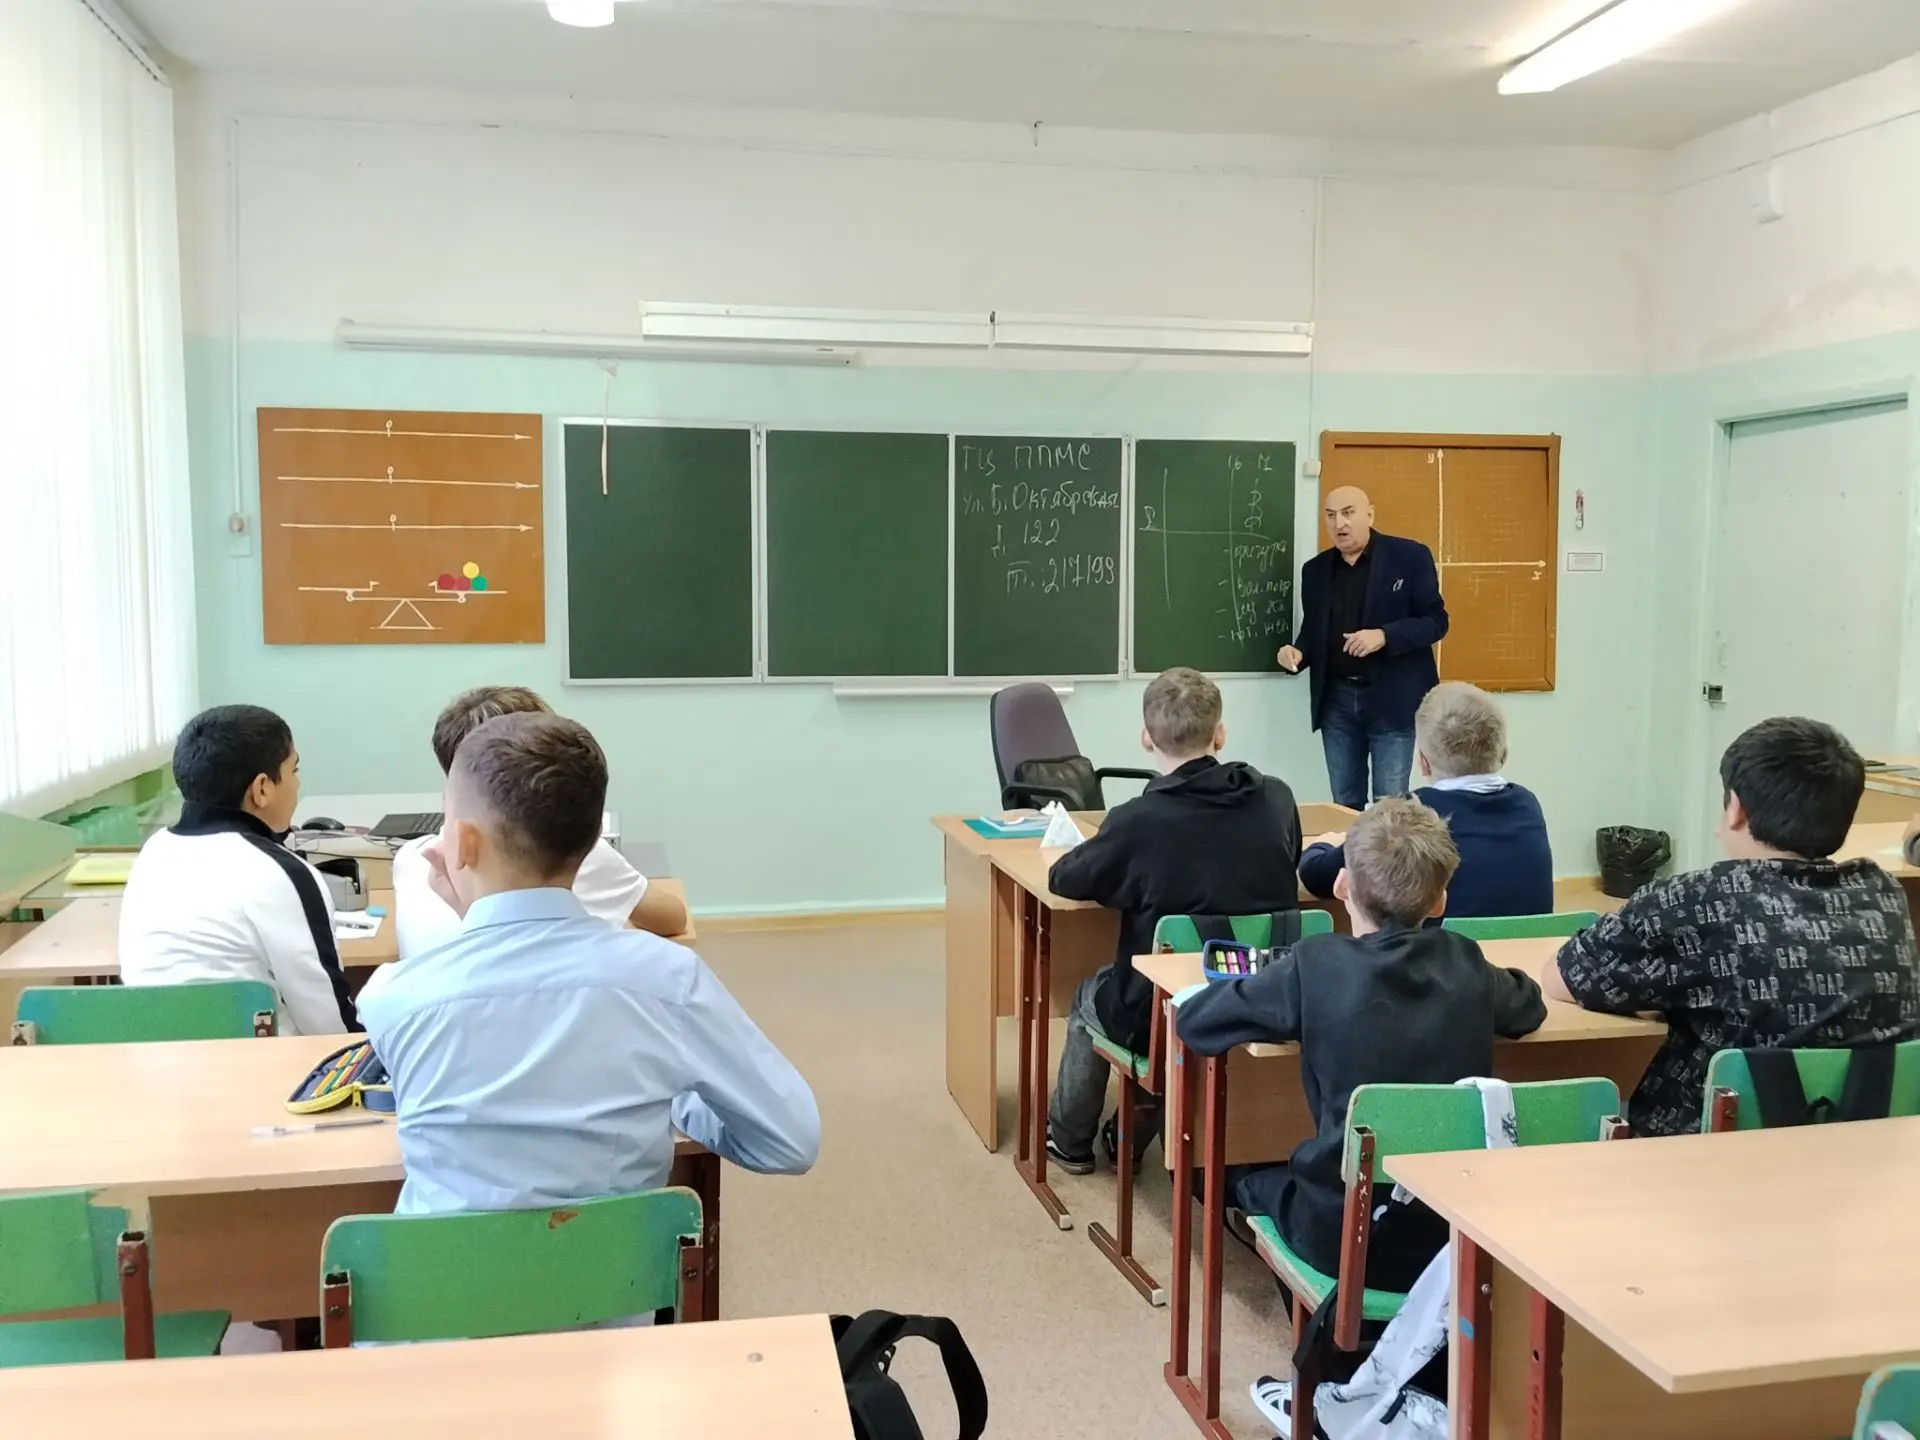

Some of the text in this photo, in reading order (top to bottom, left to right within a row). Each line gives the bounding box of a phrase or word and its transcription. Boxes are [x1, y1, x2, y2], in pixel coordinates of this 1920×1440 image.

[1014, 442, 1092, 471] ППМС
[1023, 518, 1060, 546] 122
[1694, 900, 1726, 924] GAP
[1823, 893, 1850, 914] GAP
[1734, 922, 1767, 945] GAP
[1709, 953, 1739, 977] GAP
[1776, 946, 1807, 969] GAP
[1839, 945, 1867, 967] GAP
[1747, 976, 1779, 1000] GAP
[1816, 973, 1844, 995] GAP
[1786, 1003, 1817, 1026] GAP
